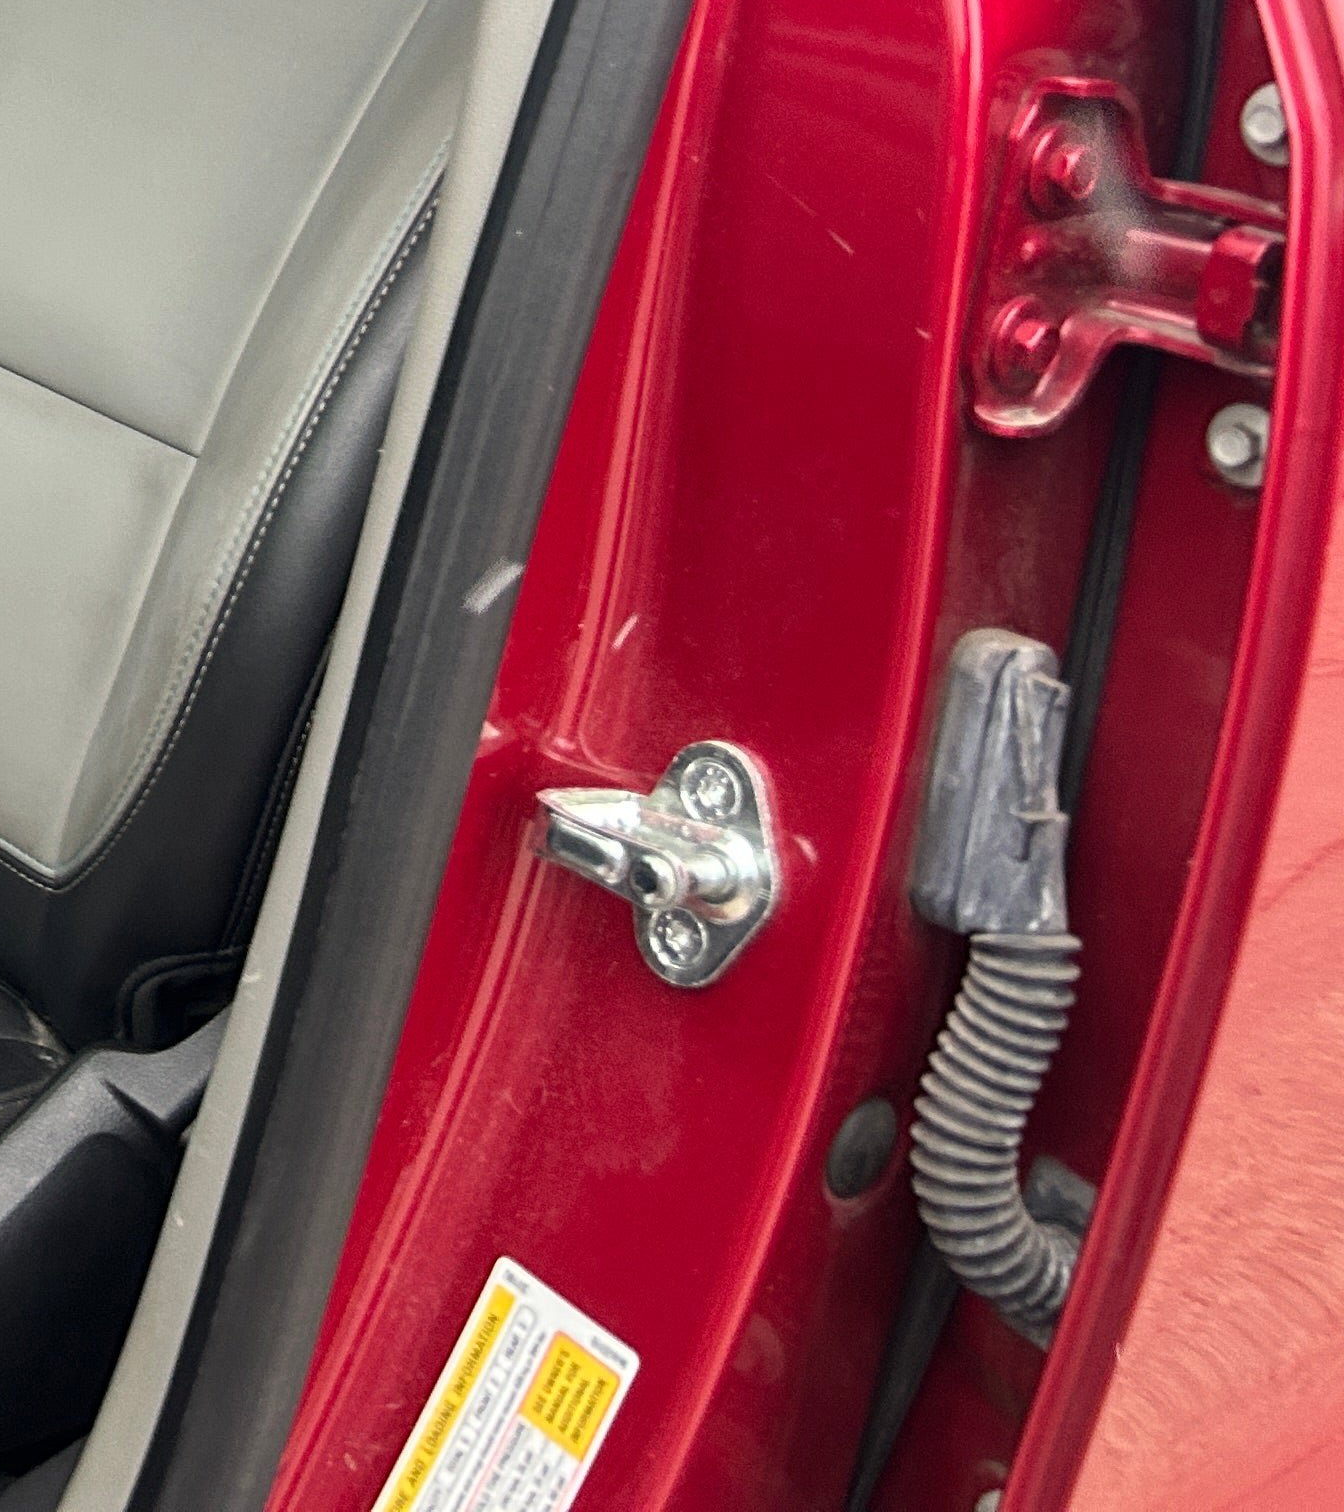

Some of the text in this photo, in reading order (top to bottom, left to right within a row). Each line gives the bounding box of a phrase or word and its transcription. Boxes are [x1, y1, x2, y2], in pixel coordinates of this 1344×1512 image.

[408, 1459, 426, 1486] AND
[424, 1400, 457, 1455] LOADING
[452, 1311, 500, 1395] INFORMATION
